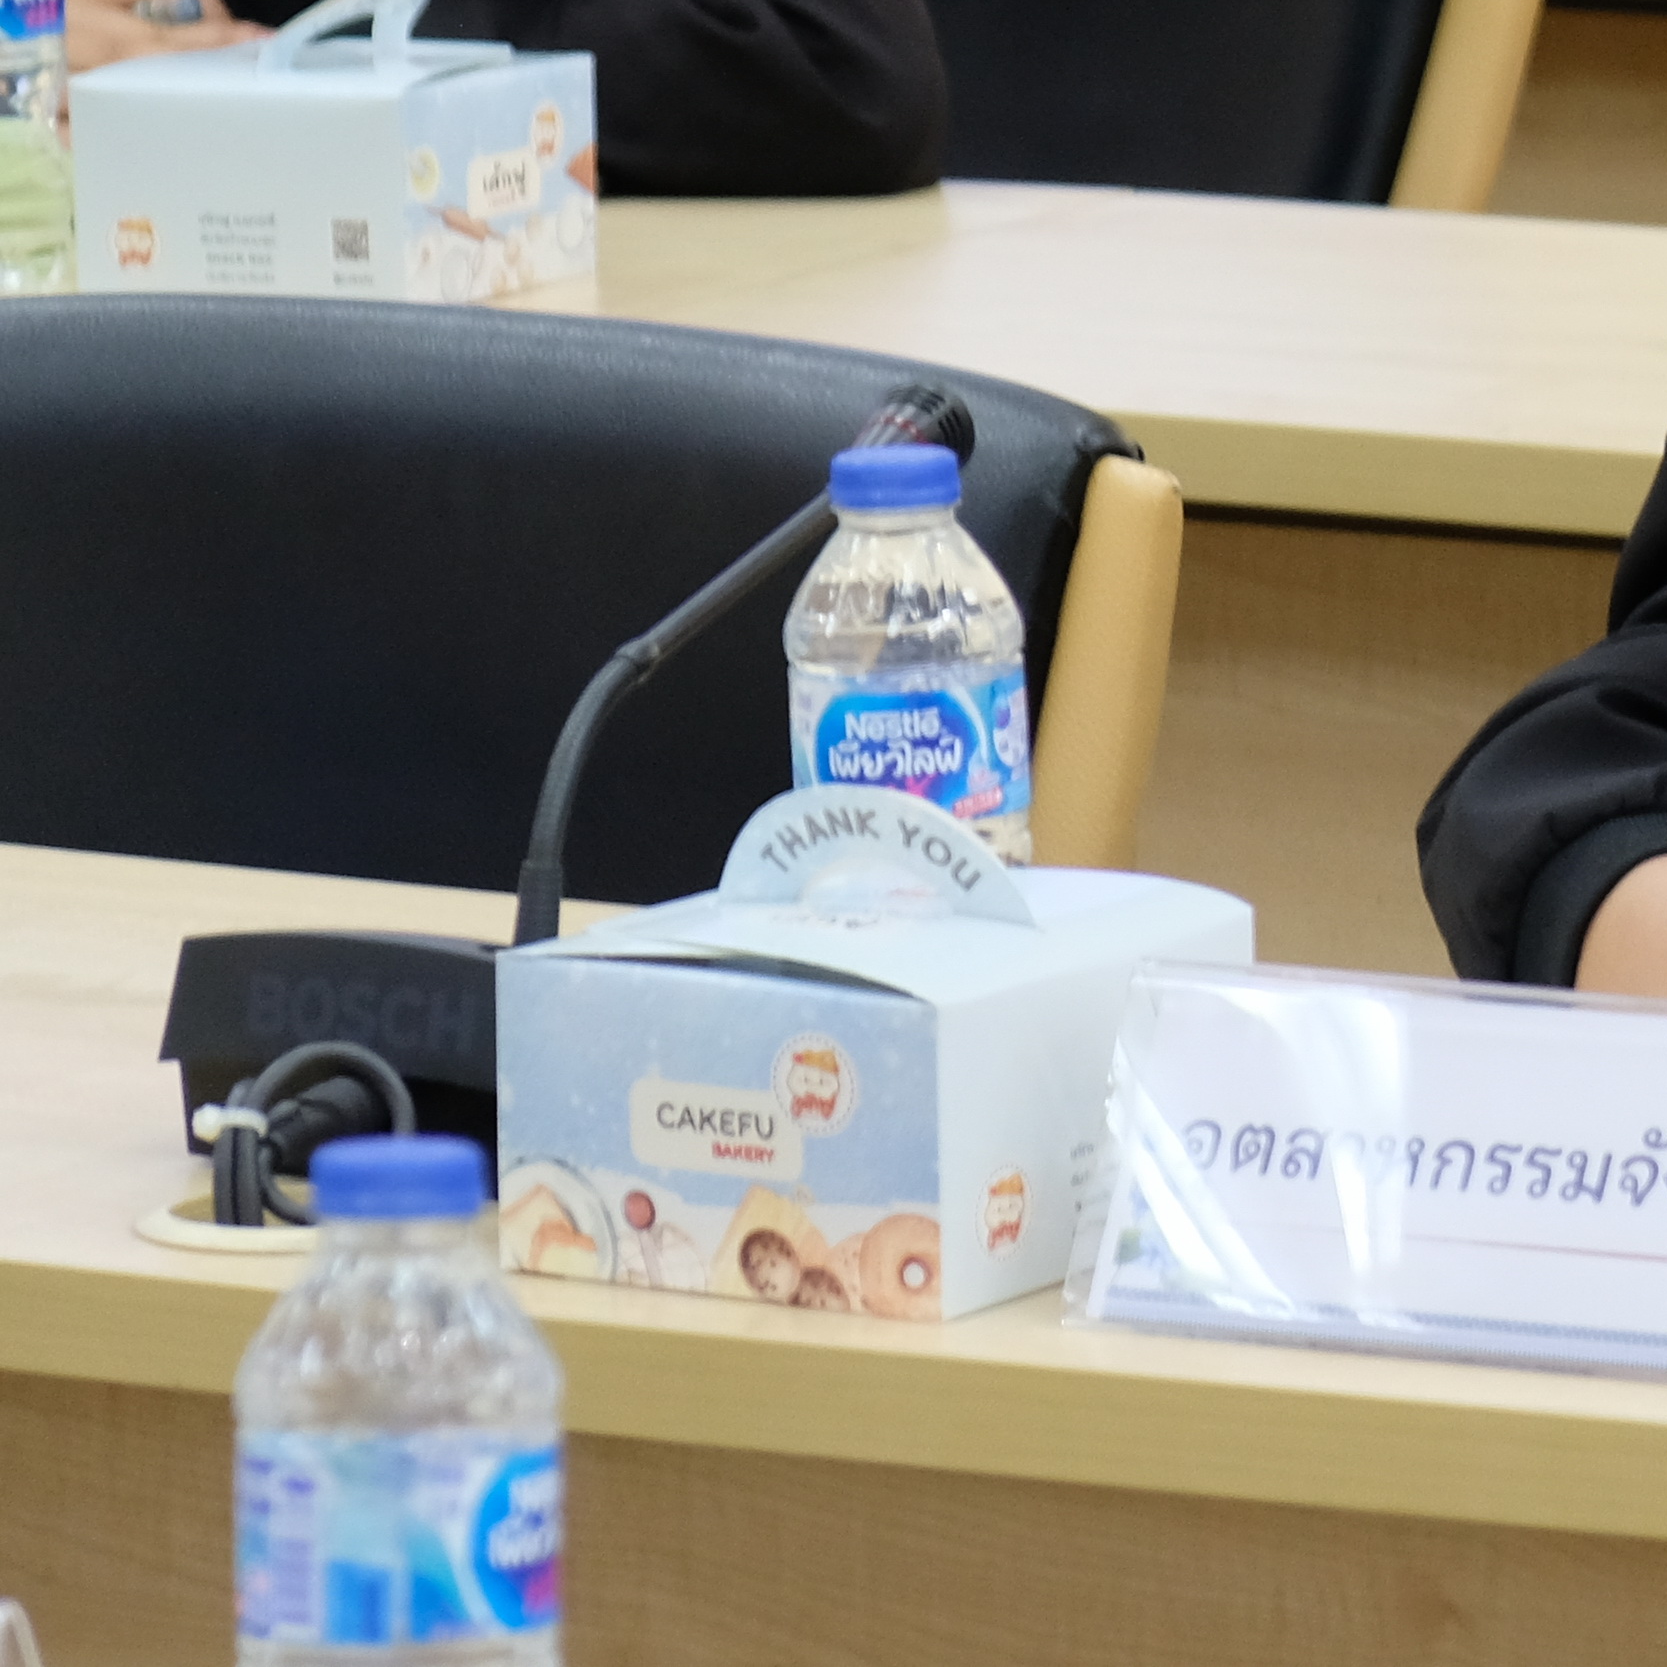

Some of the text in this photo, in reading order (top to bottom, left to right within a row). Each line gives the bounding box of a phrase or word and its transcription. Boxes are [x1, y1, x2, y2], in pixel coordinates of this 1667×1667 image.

[760, 805, 983, 893] THANK YOU
[248, 970, 476, 1056] BOSCH
[655, 1099, 776, 1142] CAKEFU
[711, 1140, 776, 1166] BAKERY
